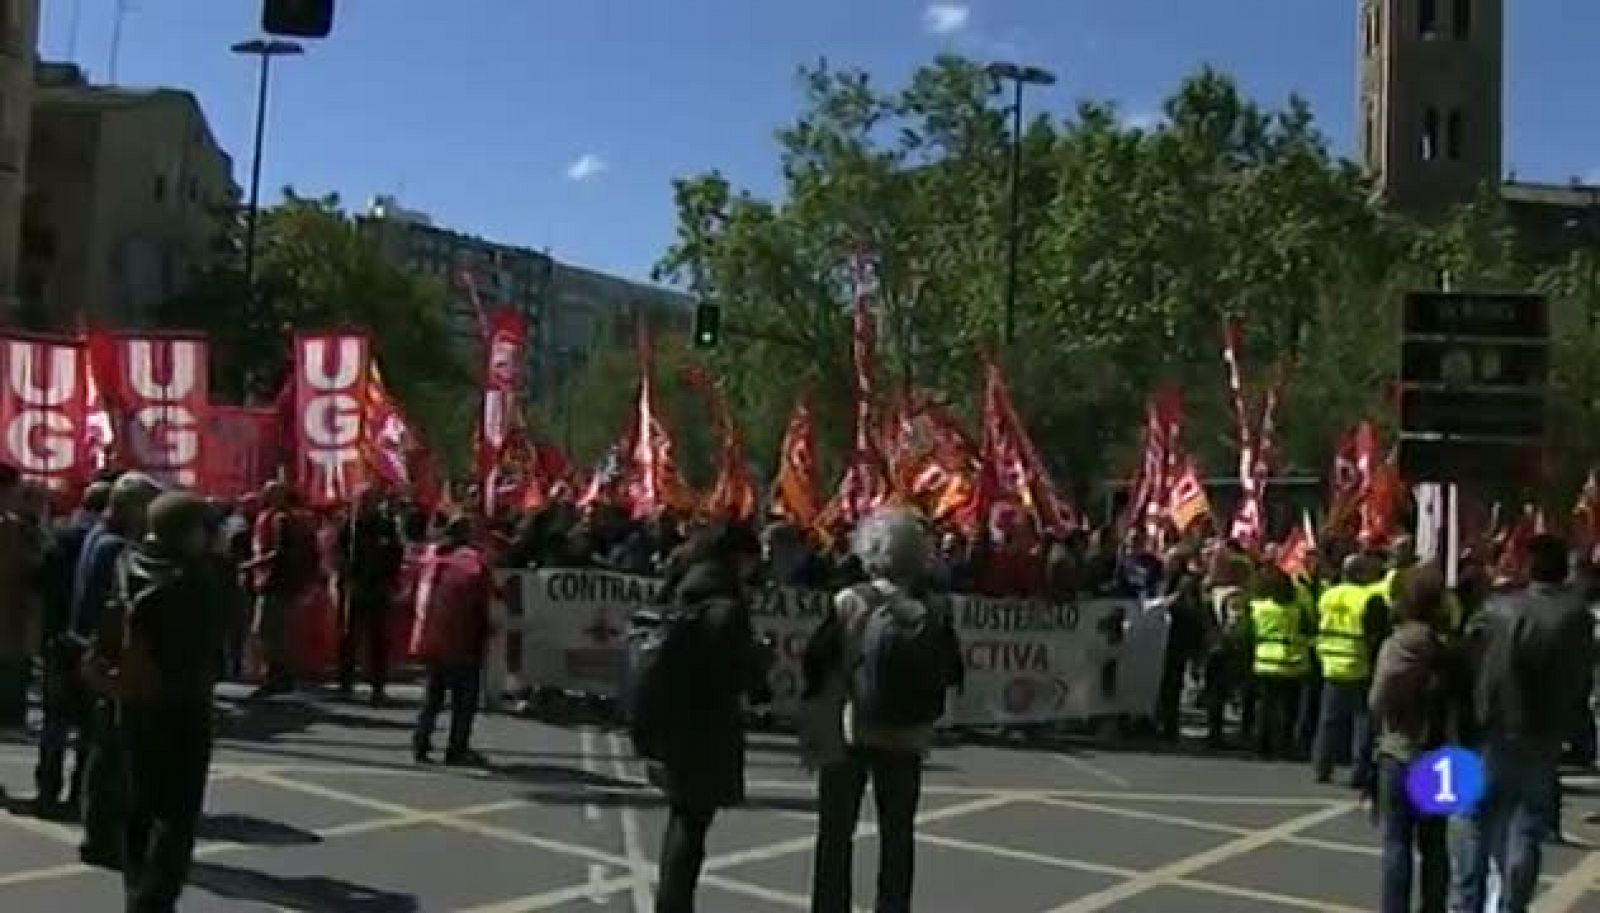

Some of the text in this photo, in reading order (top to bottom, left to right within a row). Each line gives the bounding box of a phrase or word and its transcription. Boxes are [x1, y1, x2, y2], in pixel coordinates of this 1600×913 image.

[7, 341, 77, 489] UG
[303, 336, 362, 499] UGT
[547, 572, 642, 602] CONTRA
